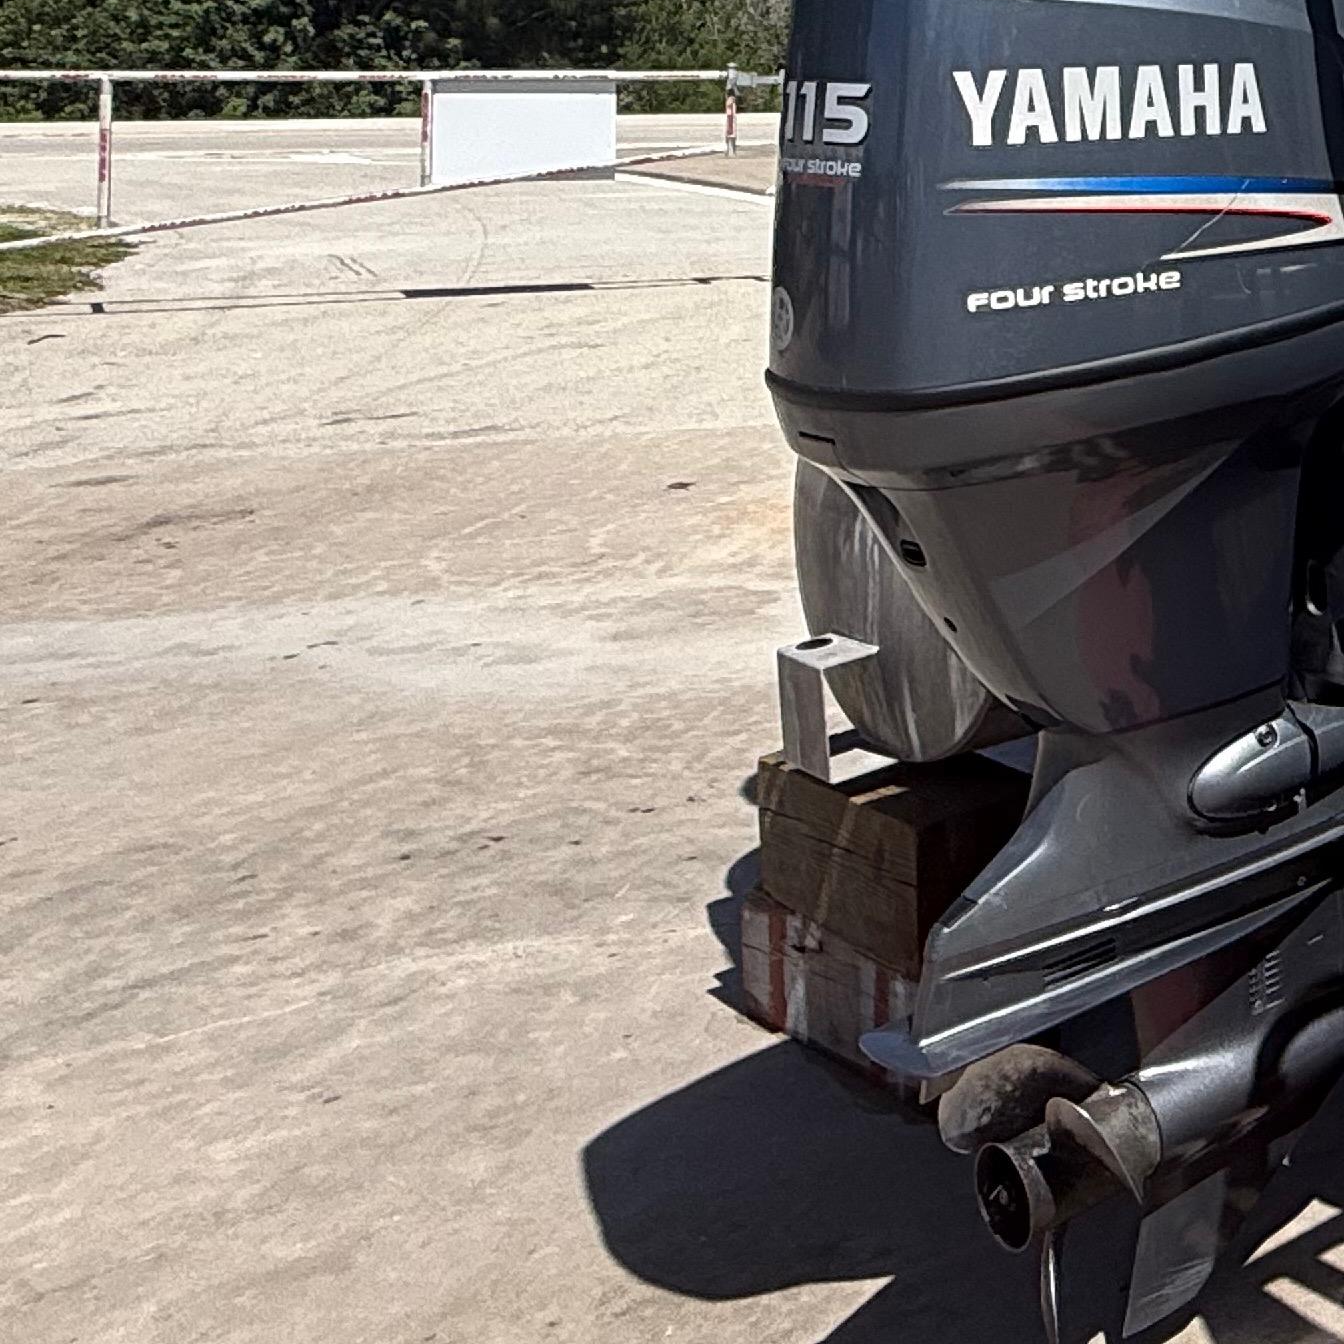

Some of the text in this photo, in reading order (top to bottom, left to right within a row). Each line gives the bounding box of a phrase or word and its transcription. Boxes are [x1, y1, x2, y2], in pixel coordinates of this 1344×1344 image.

[785, 80, 872, 144] 115
[952, 62, 1268, 146] YAMAHA
[1062, 270, 1181, 303] stroke
